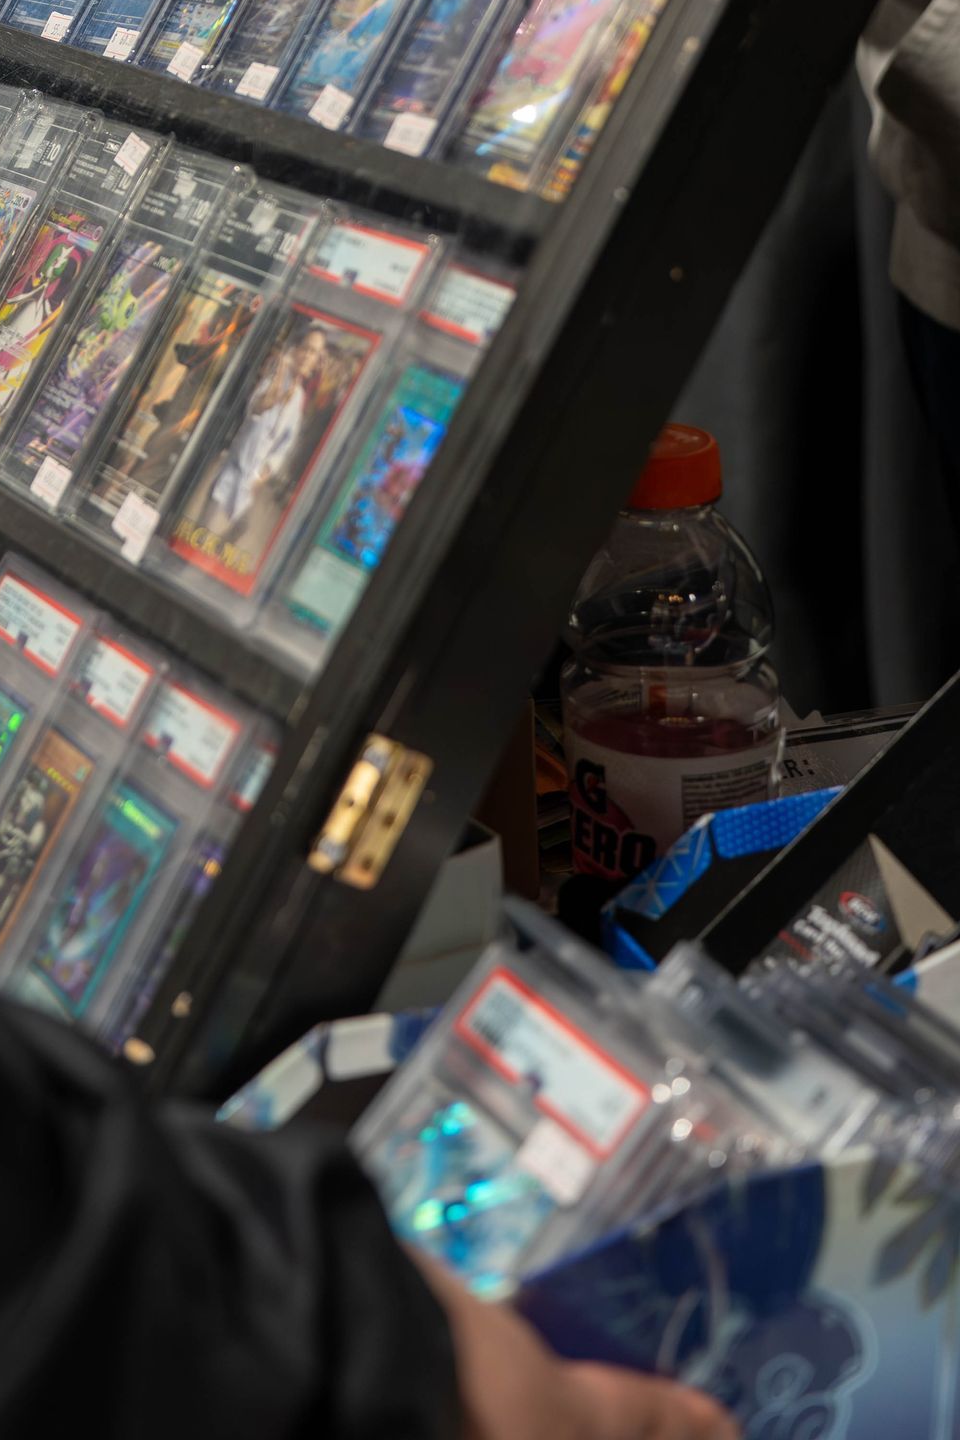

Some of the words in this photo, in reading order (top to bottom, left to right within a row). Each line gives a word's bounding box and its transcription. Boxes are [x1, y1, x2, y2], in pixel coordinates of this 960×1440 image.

[46, 142, 61, 161] 10
[575, 758, 607, 813] G
[574, 807, 657, 875] ERO
